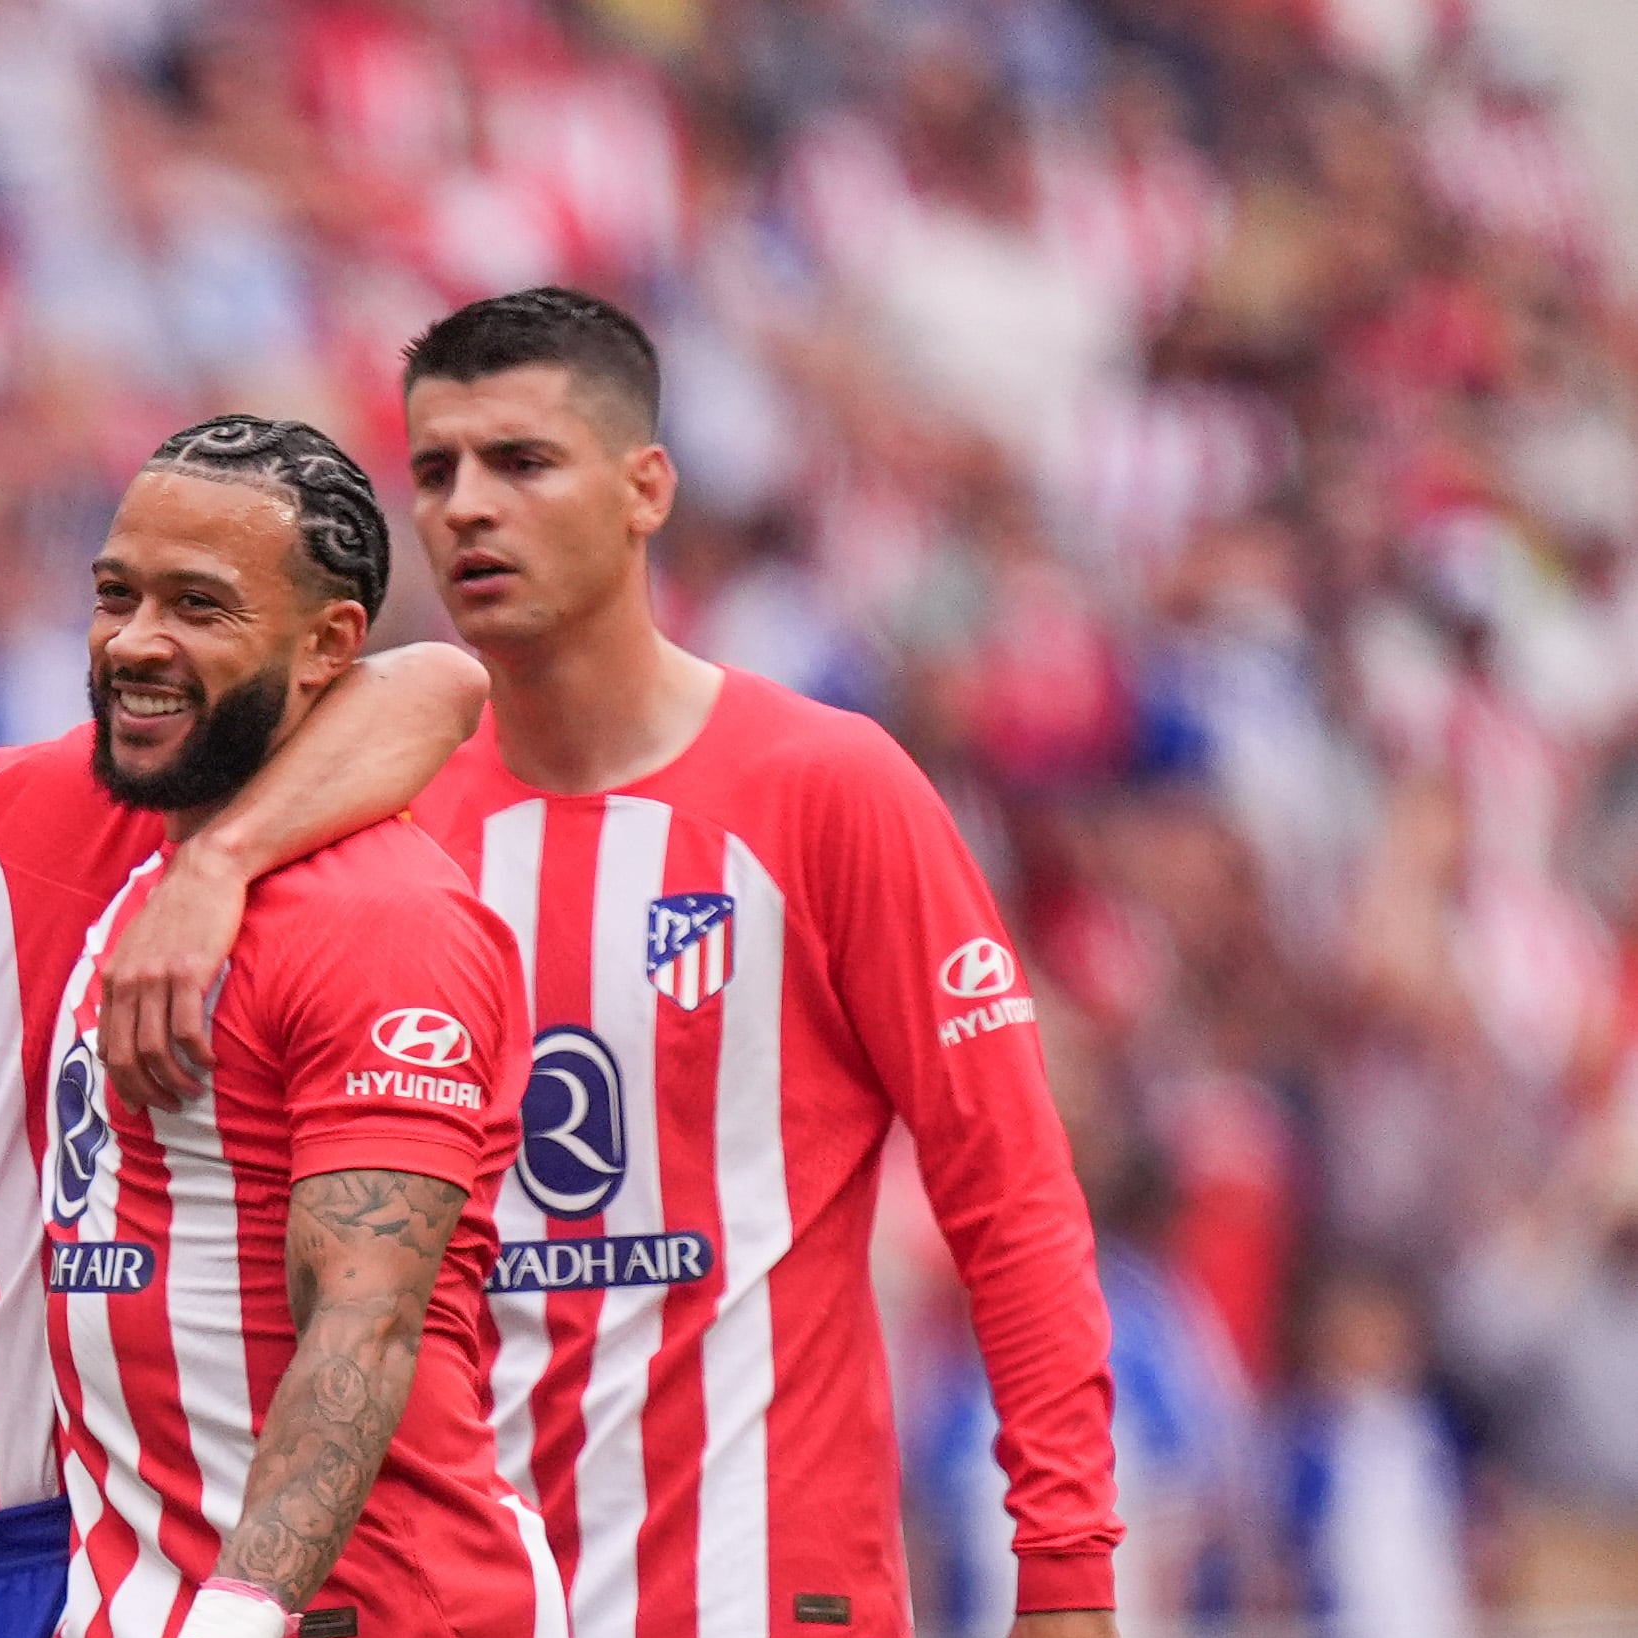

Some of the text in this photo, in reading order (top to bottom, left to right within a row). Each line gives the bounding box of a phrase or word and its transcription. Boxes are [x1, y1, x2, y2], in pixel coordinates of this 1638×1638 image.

[346, 1070, 482, 1110] HYUNDAI
[82, 1246, 144, 1288] AIR
[484, 1236, 704, 1290] YADH AIR
